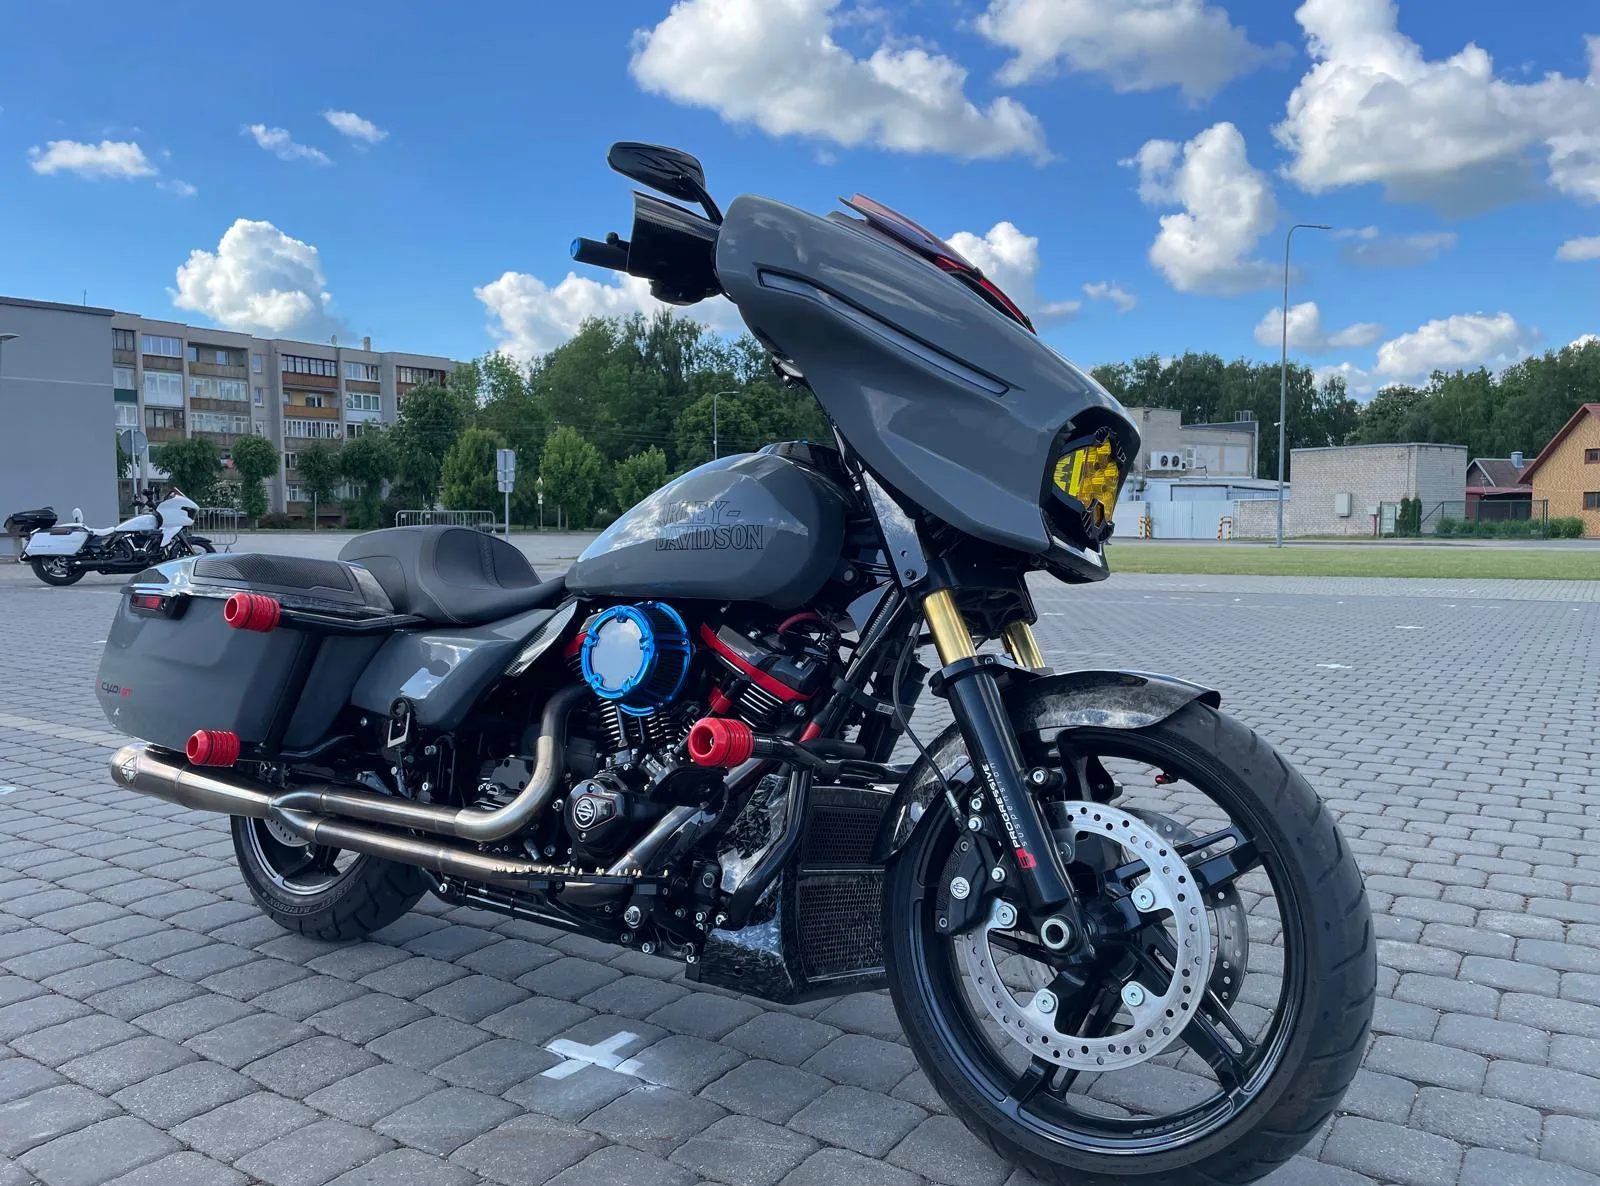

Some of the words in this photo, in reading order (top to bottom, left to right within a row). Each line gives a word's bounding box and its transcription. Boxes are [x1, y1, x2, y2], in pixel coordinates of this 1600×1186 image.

[656, 524, 764, 551] DAVIDSON
[981, 763, 1021, 848] PROGRESSIVE
[990, 762, 1028, 847] suspension
